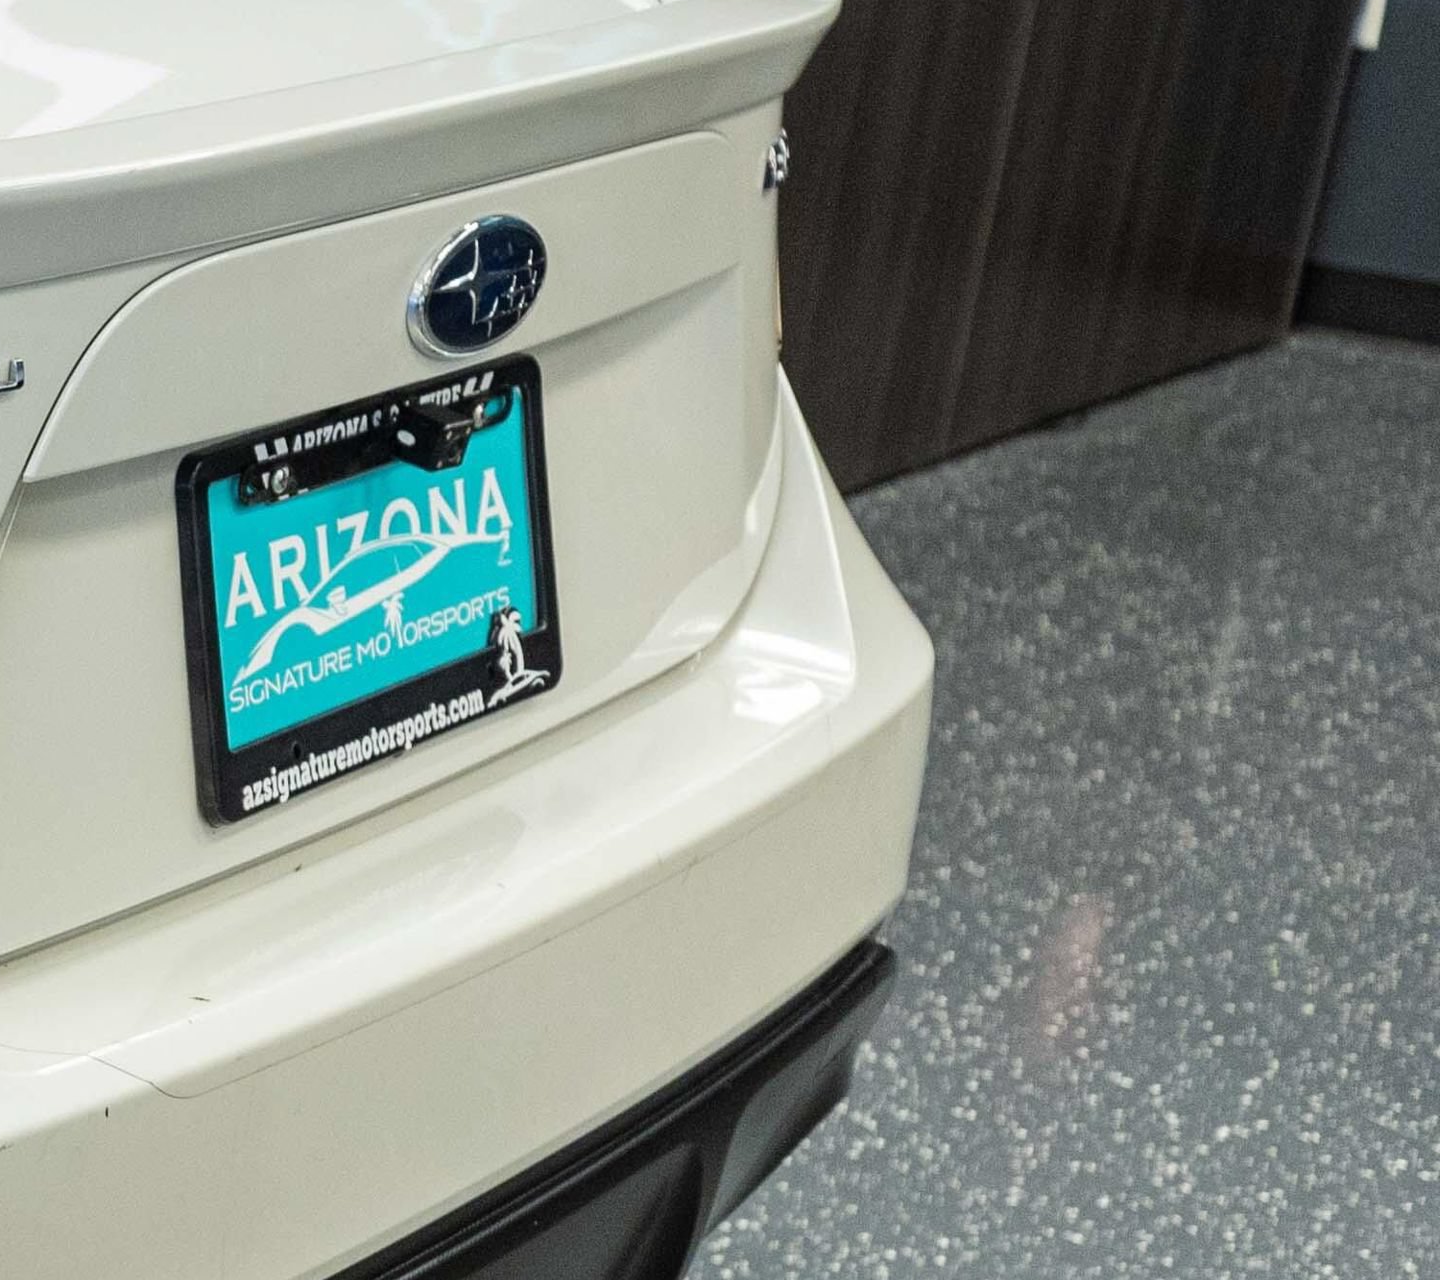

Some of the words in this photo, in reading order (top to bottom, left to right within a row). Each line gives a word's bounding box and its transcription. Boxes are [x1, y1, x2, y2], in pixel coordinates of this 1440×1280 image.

[225, 467, 513, 628] ARIZONA
[229, 645, 352, 712] SIGNATURE
[356, 586, 511, 665] MOTORSPORTS
[242, 688, 485, 811] azsignaturemotorsports.com
